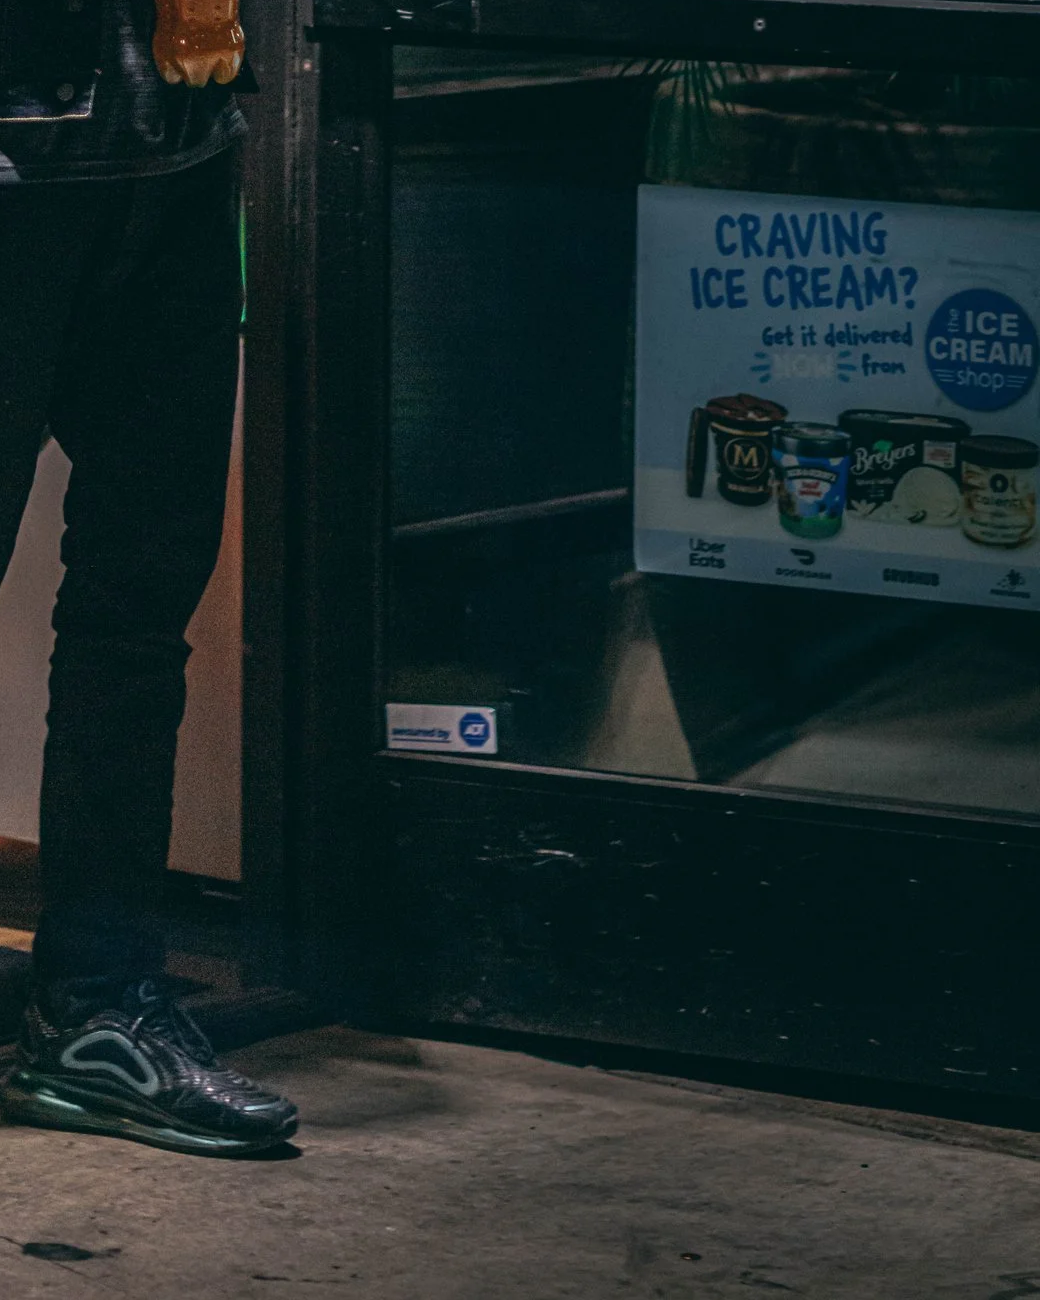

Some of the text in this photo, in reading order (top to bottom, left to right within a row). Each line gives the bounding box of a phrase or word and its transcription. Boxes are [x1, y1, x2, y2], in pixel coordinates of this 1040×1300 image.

[715, 211, 888, 259] CRAVING
[690, 264, 919, 311] ICE CREAM?
[761, 322, 913, 347] Get it delivered
[964, 310, 1020, 338] ICE
[861, 353, 906, 377] from
[928, 337, 1033, 368] CREAM
[956, 367, 1005, 393] shop
[733, 444, 759, 469] M
[850, 443, 916, 475] Breyers
[689, 538, 726, 554] Uber
[689, 553, 726, 570] Eats
